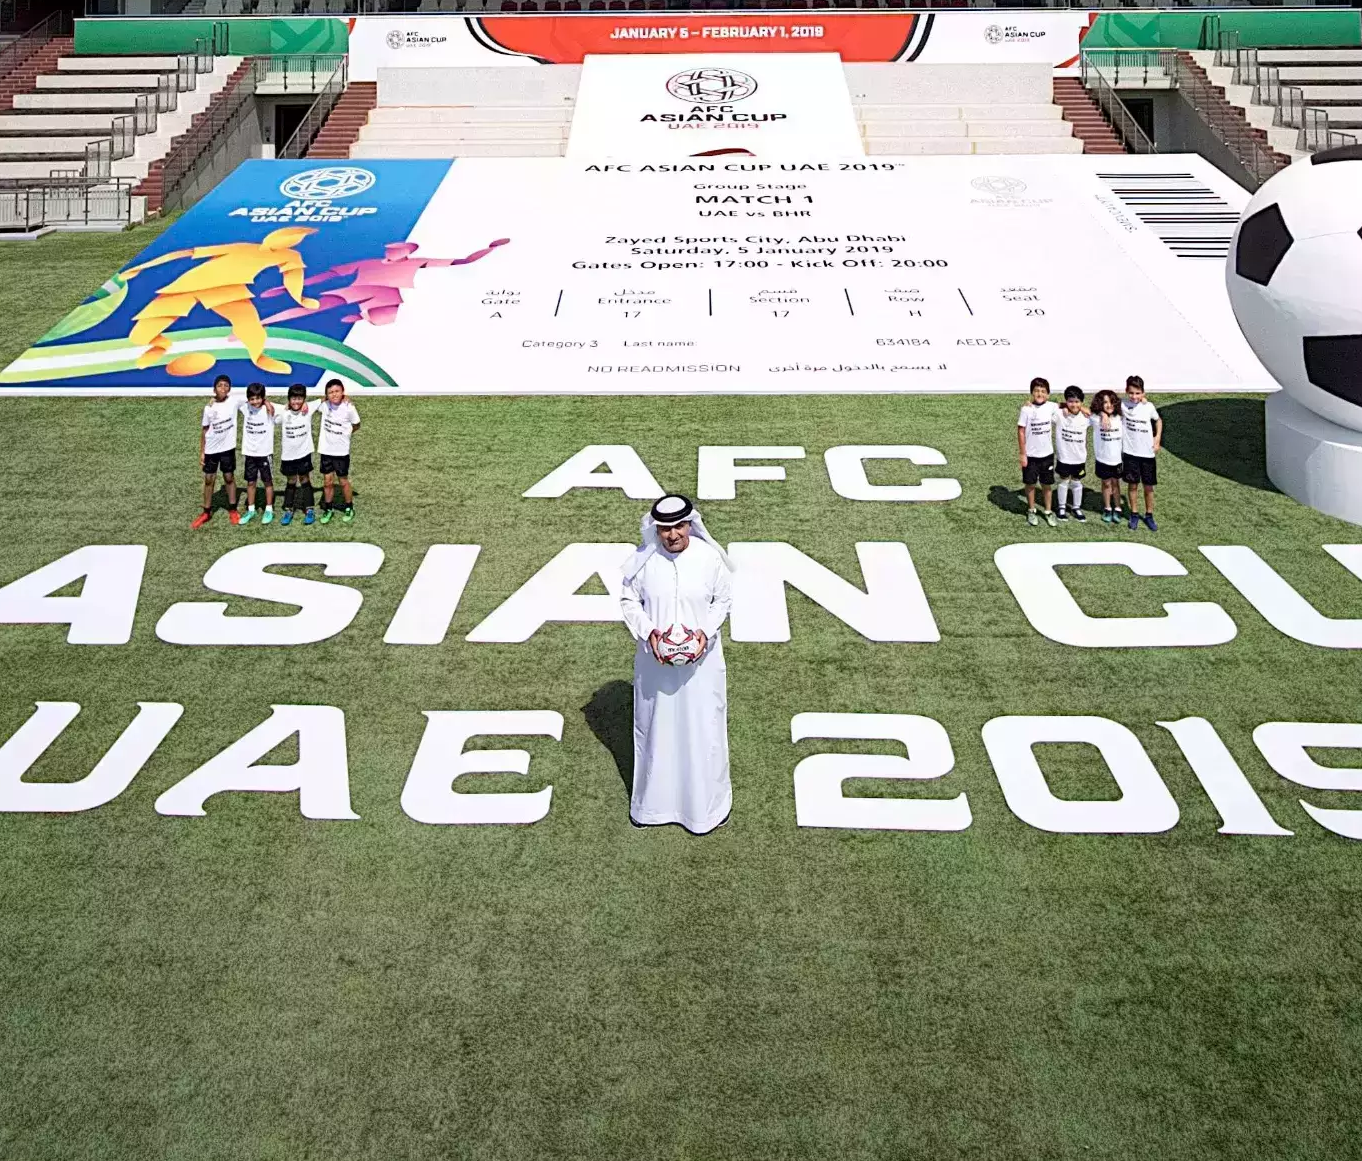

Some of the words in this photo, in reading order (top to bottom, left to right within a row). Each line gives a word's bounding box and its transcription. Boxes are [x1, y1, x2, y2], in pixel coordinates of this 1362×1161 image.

[610, 27, 677, 39] JANUARY
[702, 26, 778, 38] FEBRUARY
[790, 26, 823, 38] 2019
[689, 105, 735, 113] AFC
[640, 113, 724, 122] ASIAN
[731, 113, 788, 122] CUP
[585, 164, 632, 173] AFC
[639, 164, 715, 173] ASIAN
[724, 164, 772, 172] CUP
[780, 163, 830, 172] UAE
[696, 196, 791, 204] MATCH
[228, 207, 313, 216] ASIAN
[319, 207, 378, 216] CUP
[605, 237, 666, 245] Zayed
[675, 236, 737, 244] Sports
[631, 247, 729, 256] Saturday,
[756, 247, 836, 255] January
[572, 261, 631, 270] Gates
[641, 261, 704, 270] Open:
[714, 260, 768, 269] 17:00
[791, 260, 834, 268] Kick
[843, 260, 883, 268] Off:
[892, 260, 948, 268] 20:00
[749, 295, 809, 303] Section
[522, 340, 585, 348] Category
[523, 444, 962, 502] AFC
